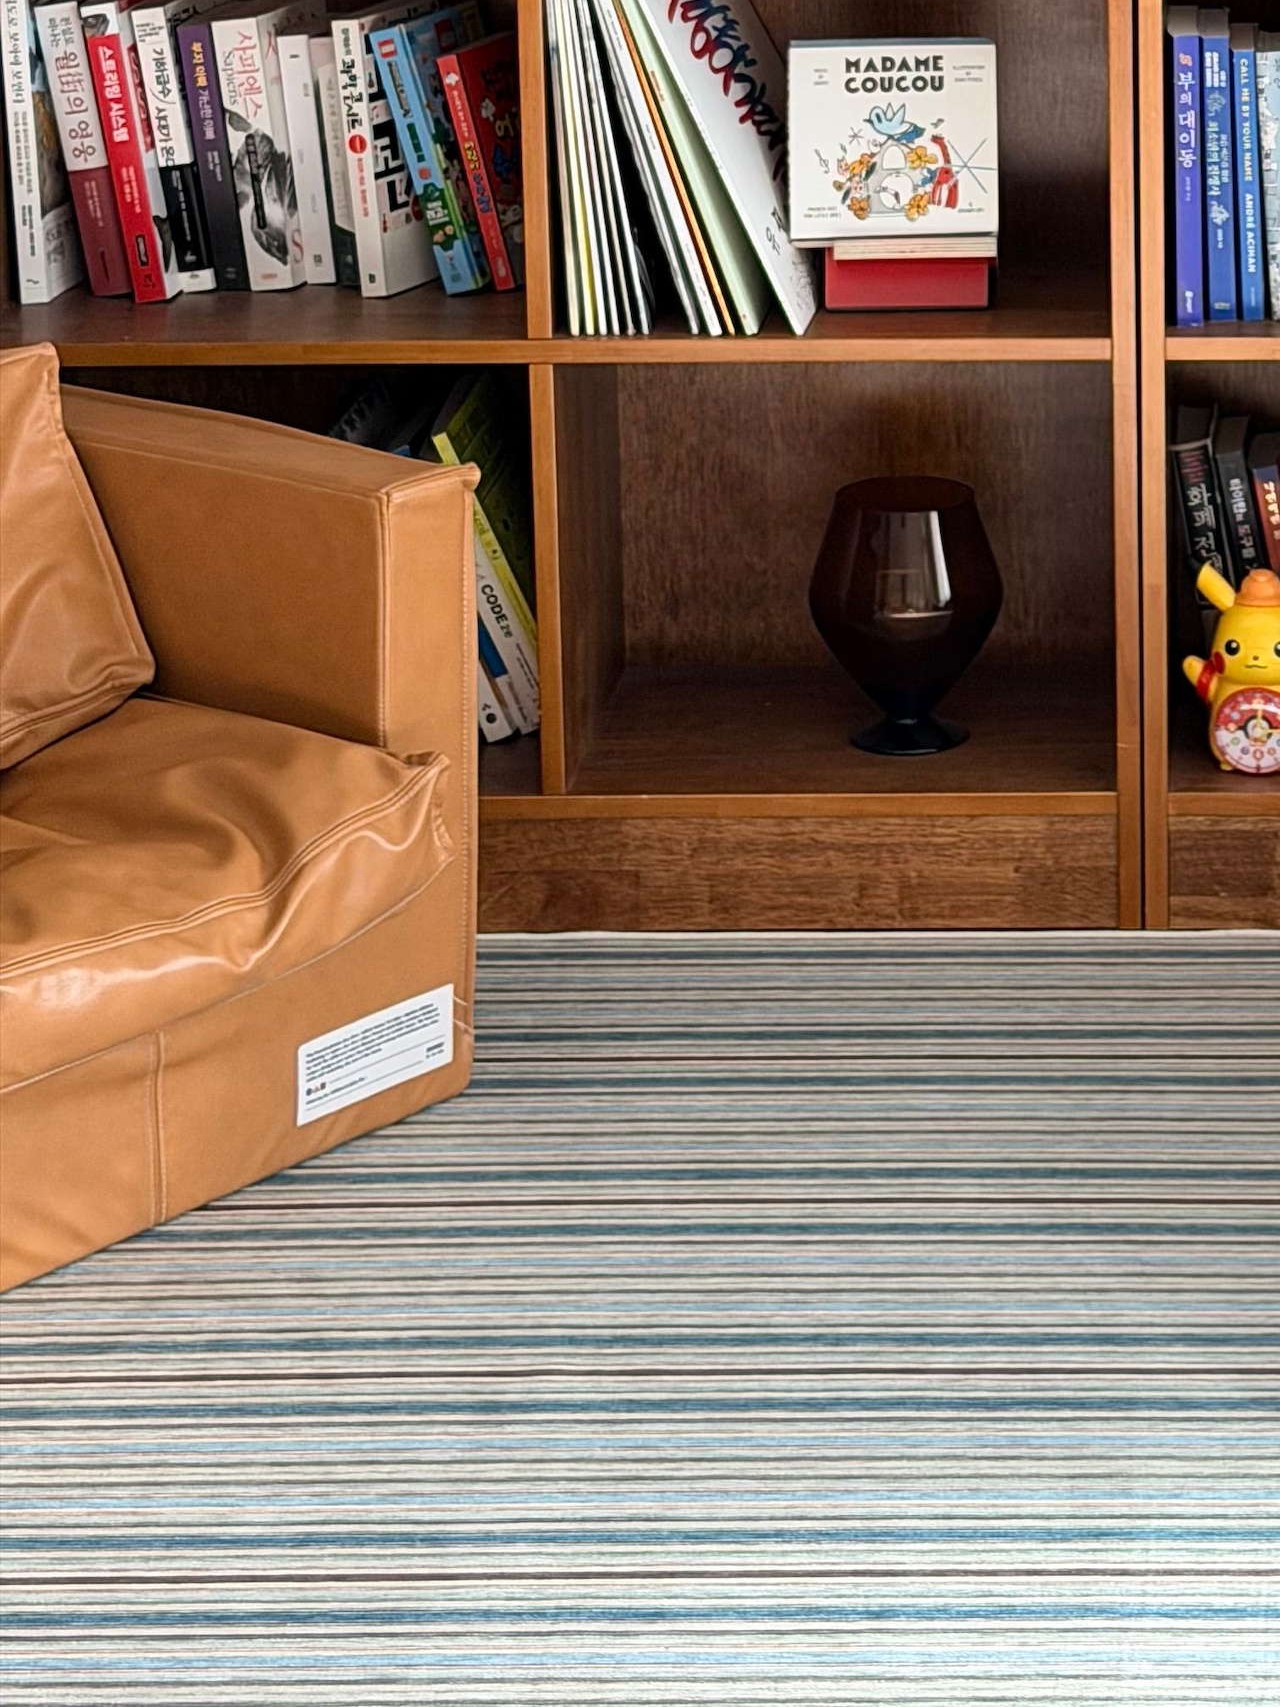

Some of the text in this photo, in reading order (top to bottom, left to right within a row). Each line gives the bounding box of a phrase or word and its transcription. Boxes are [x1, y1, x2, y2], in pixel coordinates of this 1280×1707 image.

[221, 51, 240, 106] Sapiens
[233, 31, 263, 119] 사피엔스
[340, 58, 362, 89] 과학
[844, 75, 944, 94] COUCOU
[845, 55, 944, 73] MADAME
[1239, 58, 1253, 182] CALL ME BY YOUR NAME
[68, 120, 97, 163] 영웅
[1245, 231, 1257, 273] ACIMAN
[480, 583, 508, 624] CODE
